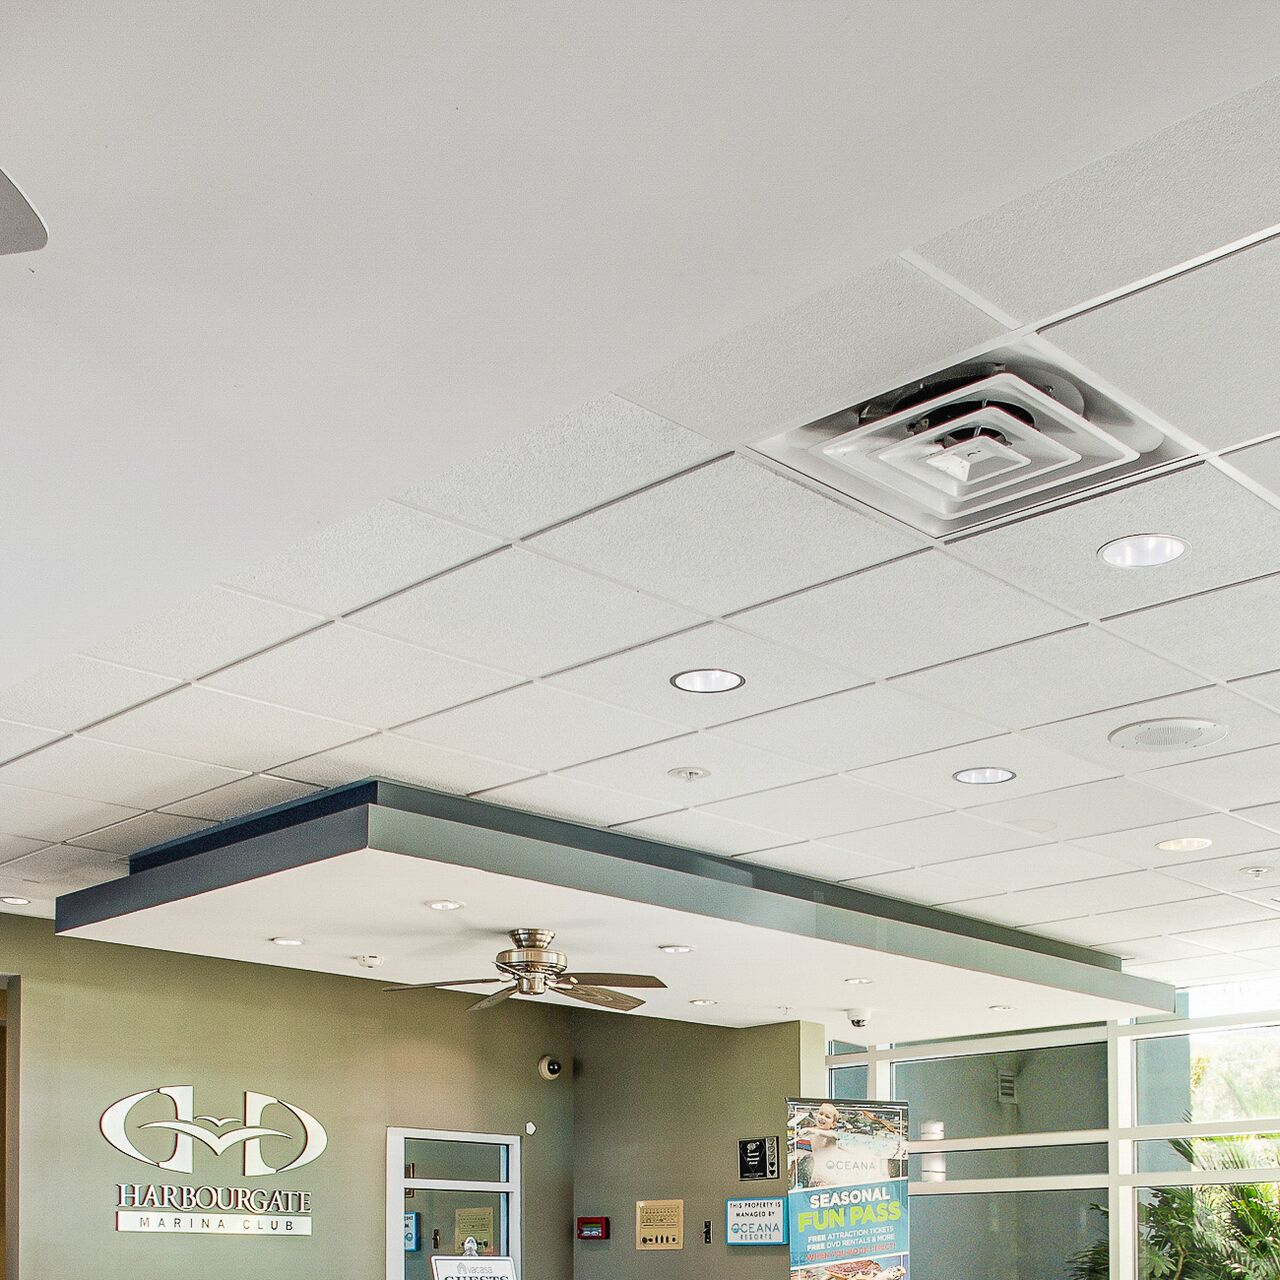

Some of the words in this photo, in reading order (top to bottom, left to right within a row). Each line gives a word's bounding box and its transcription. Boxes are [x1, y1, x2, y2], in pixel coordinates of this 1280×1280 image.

[826, 1160, 877, 1170] OCEANA
[117, 1184, 313, 1214] HARBOURGATE
[810, 1187, 891, 1209] SEASONAL
[139, 1217, 226, 1230] MARINA
[242, 1219, 294, 1231] CLUB
[798, 1208, 845, 1233] FUN
[850, 1202, 901, 1226] PASS
[731, 1223, 780, 1233] OCEANA
[808, 1234, 826, 1243] FREE
[828, 1230, 869, 1240] ATTRACTION
[807, 1242, 826, 1251] FREE
[827, 1241, 841, 1249] DVD
[806, 1252, 830, 1261] WHEN
